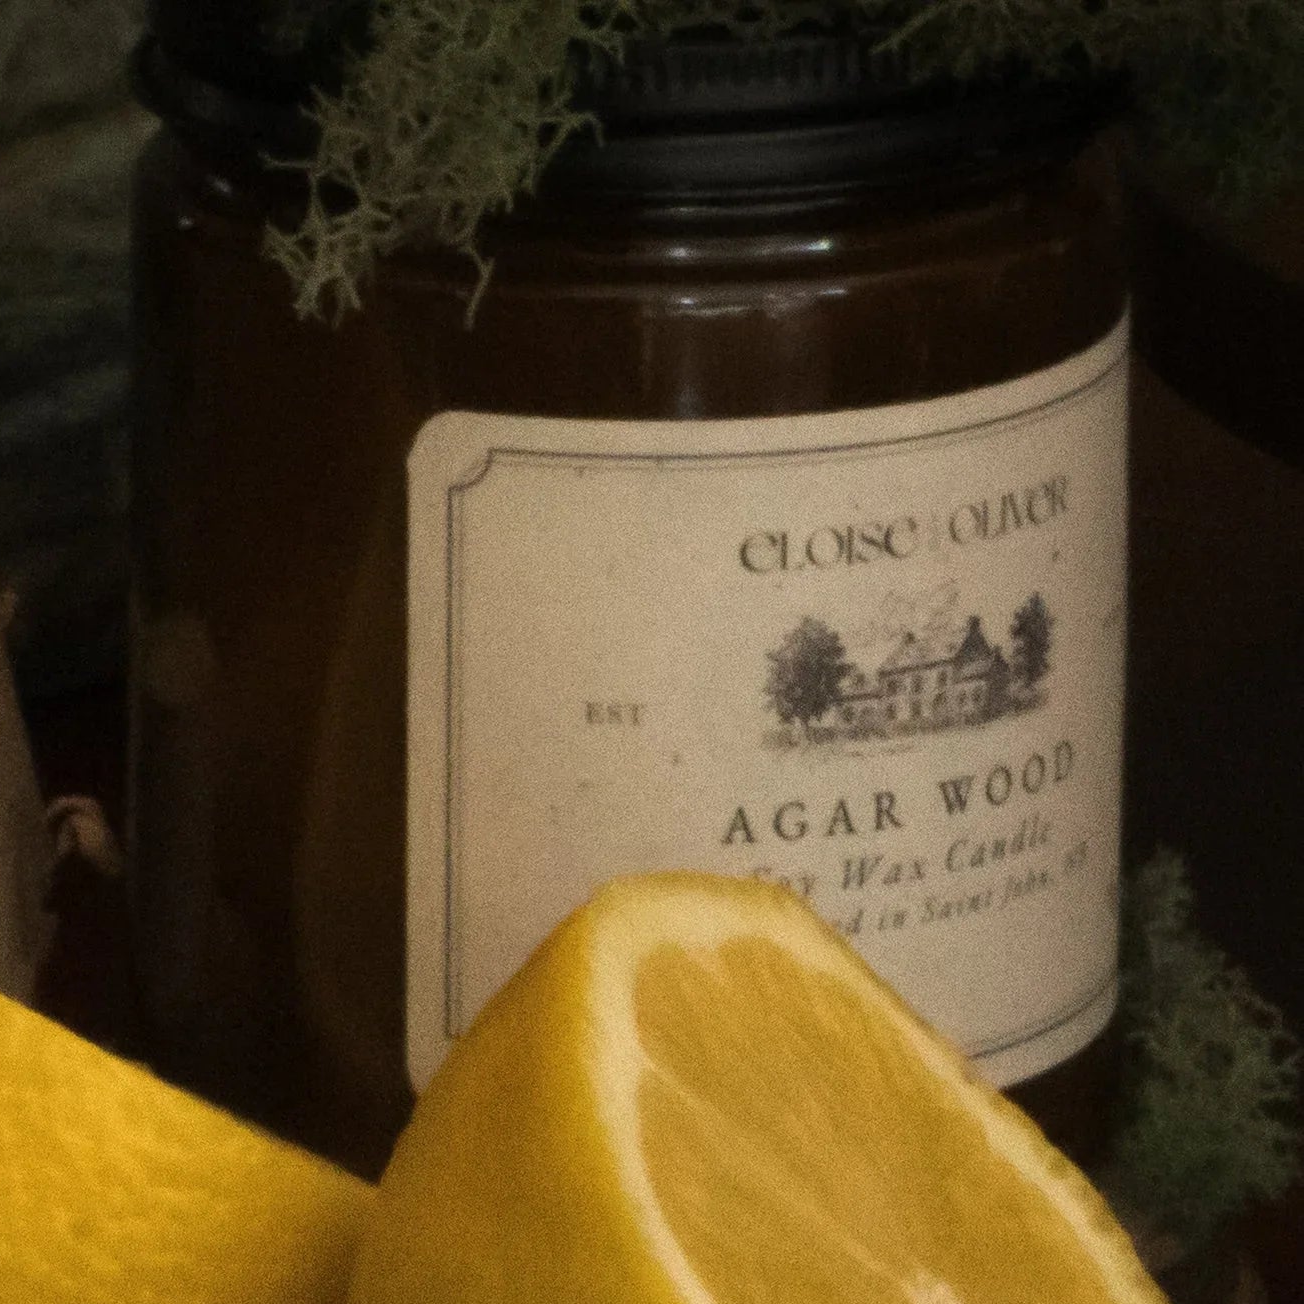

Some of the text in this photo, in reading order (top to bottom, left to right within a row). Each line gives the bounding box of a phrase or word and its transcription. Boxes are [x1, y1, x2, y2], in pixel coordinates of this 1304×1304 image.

[583, 699, 645, 727] EST
[719, 738, 1074, 846] AGAR WOOD
[840, 854, 927, 891] Wax
[943, 812, 1053, 873] Candle
